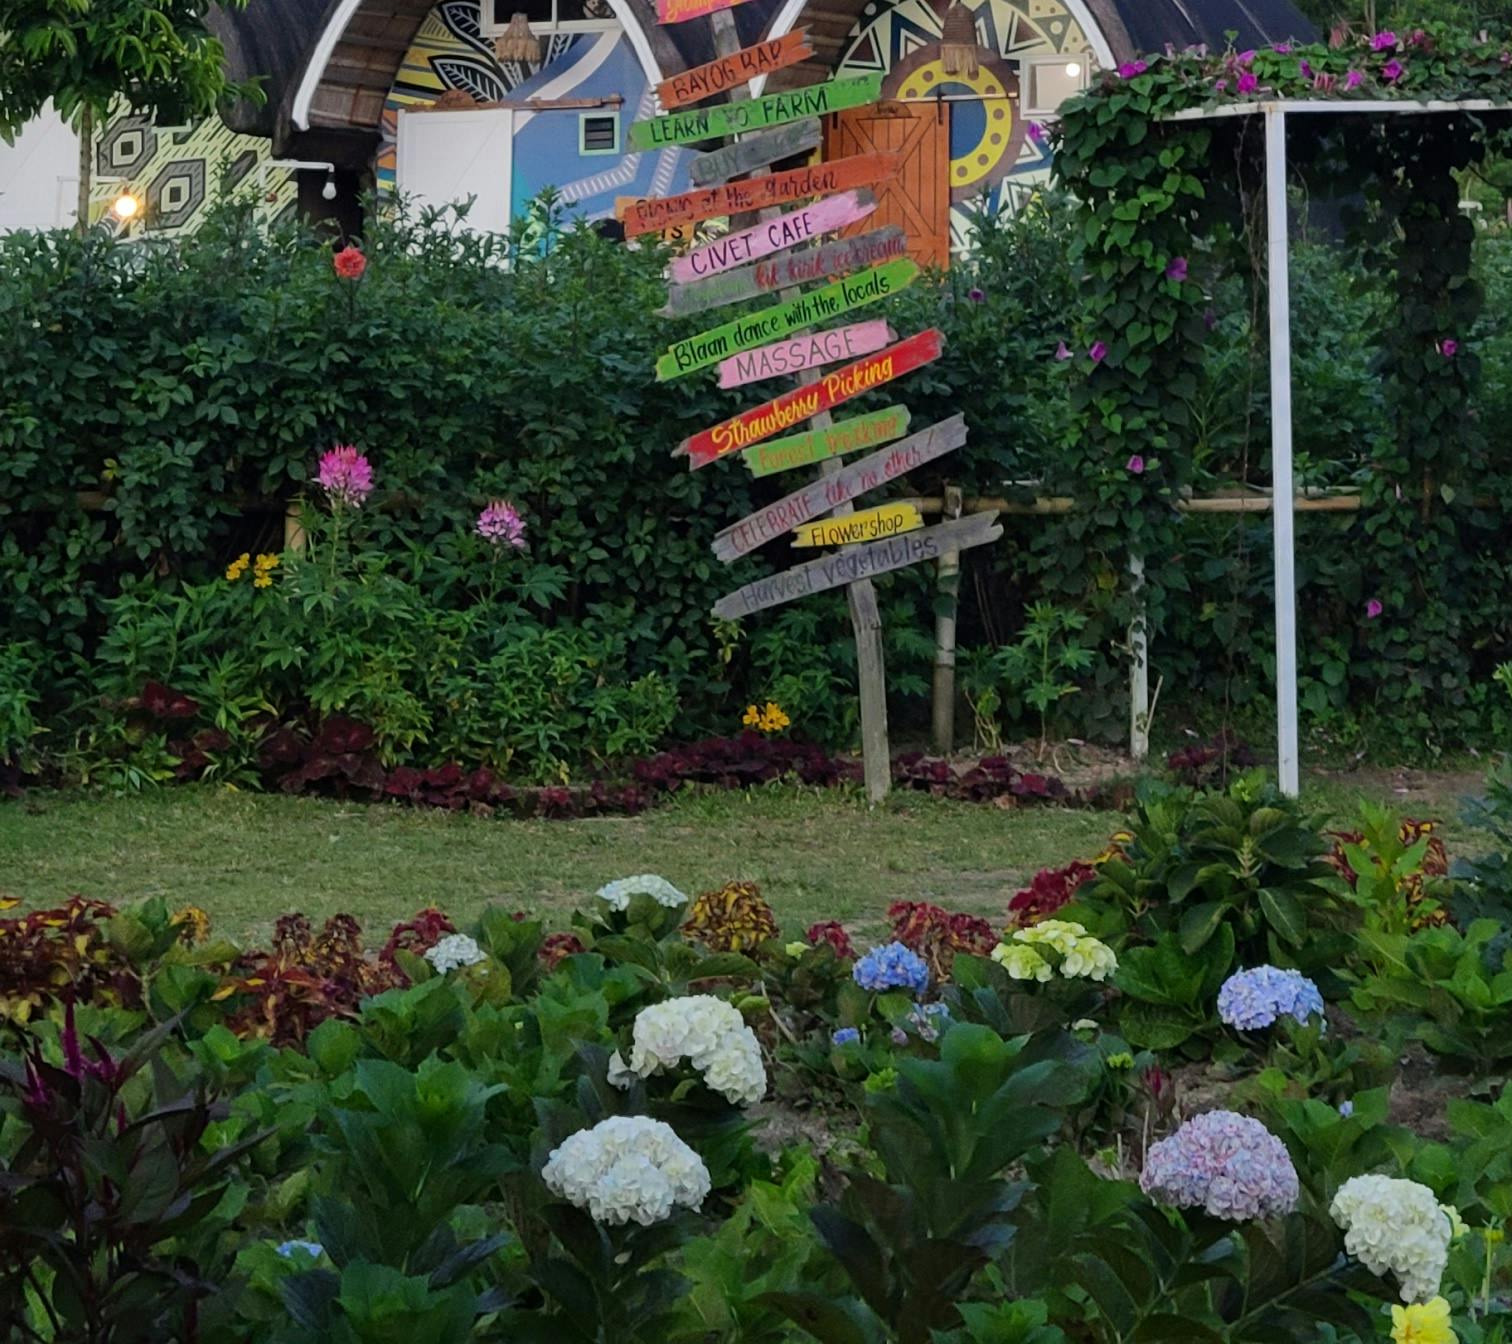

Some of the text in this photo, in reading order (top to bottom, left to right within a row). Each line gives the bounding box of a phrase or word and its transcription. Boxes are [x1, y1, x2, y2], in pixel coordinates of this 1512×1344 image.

[651, 113, 709, 143] LEARN
[762, 88, 828, 123] FARM
[691, 212, 812, 274] CIVET CAFE
[734, 315, 779, 347] dance
[784, 302, 812, 328] with
[842, 273, 890, 306] locals
[736, 329, 857, 380] MASSAGE
[712, 356, 893, 453] Strawberry Picking
[731, 494, 812, 553] CELEBRATE
[741, 536, 938, 610] Harvest vegetables
